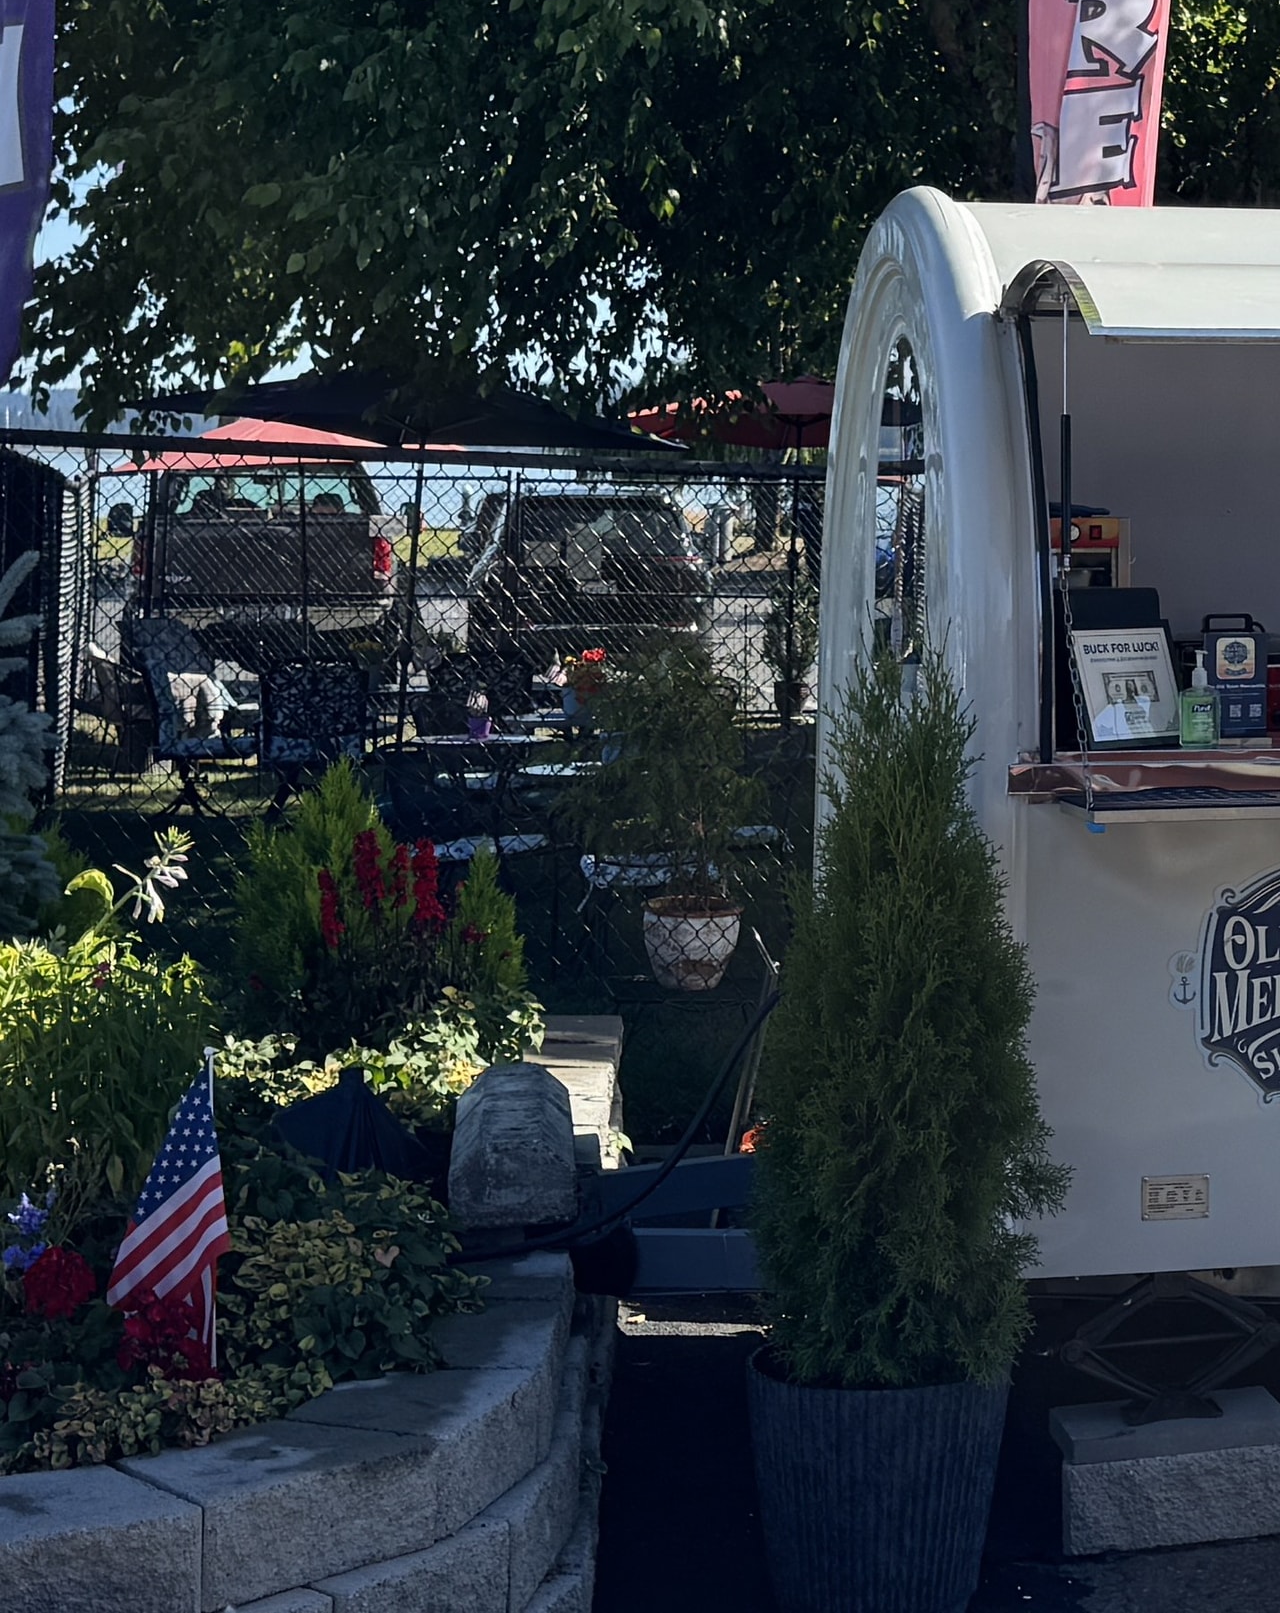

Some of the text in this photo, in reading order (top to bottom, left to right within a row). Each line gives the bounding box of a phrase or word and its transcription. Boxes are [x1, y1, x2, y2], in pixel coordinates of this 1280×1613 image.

[1083, 641, 1159, 655] BUCK FOR LUCK!
